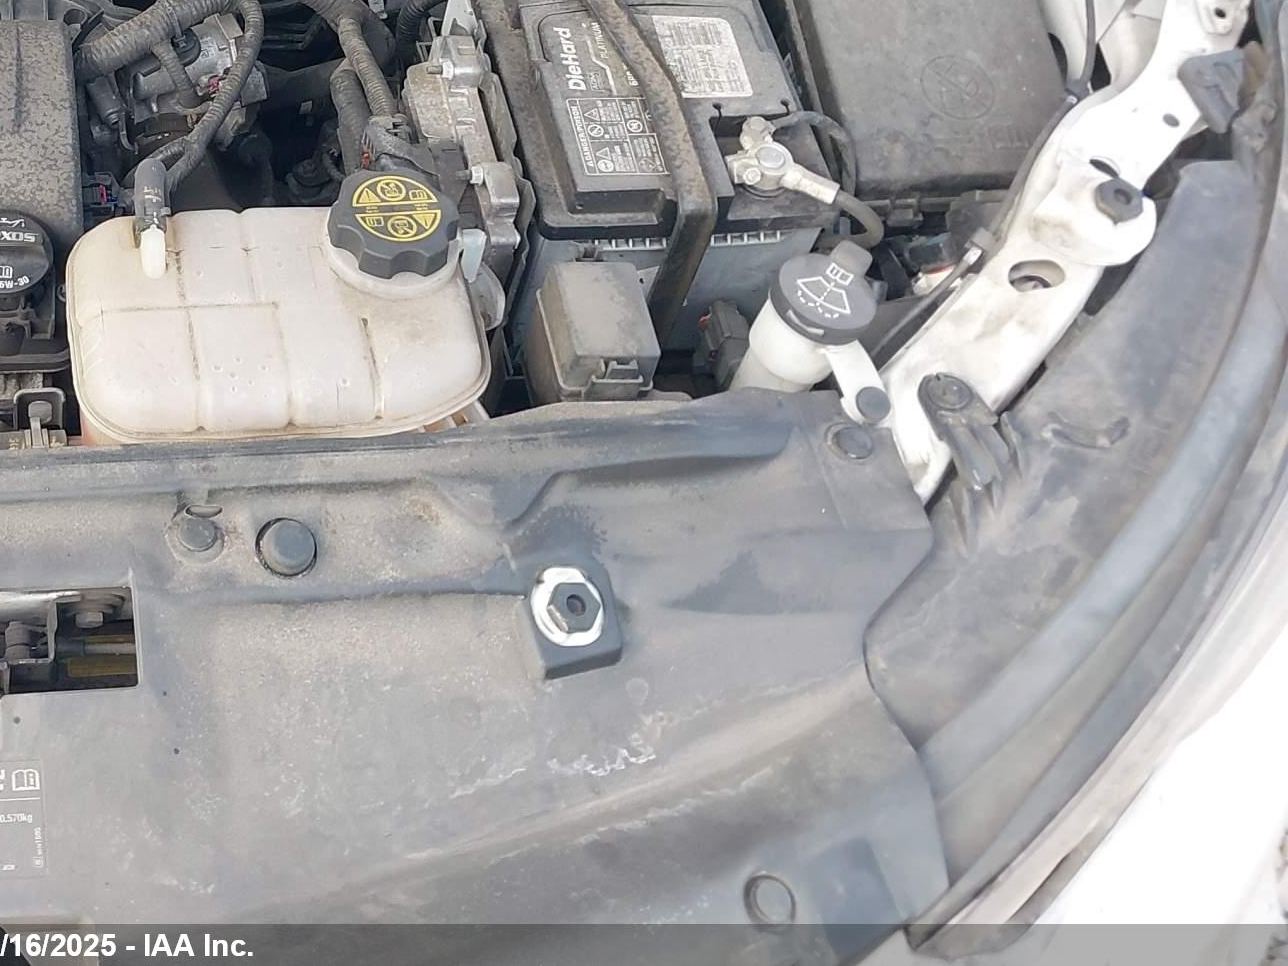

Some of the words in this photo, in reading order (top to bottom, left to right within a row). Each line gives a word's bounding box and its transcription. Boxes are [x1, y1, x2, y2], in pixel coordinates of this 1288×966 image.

[591, 22, 609, 59] PLATINUM
[553, 26, 587, 91] DieHard
[0, 275, 30, 289] 5W-30
[0, 813, 33, 824] 0.570kg
